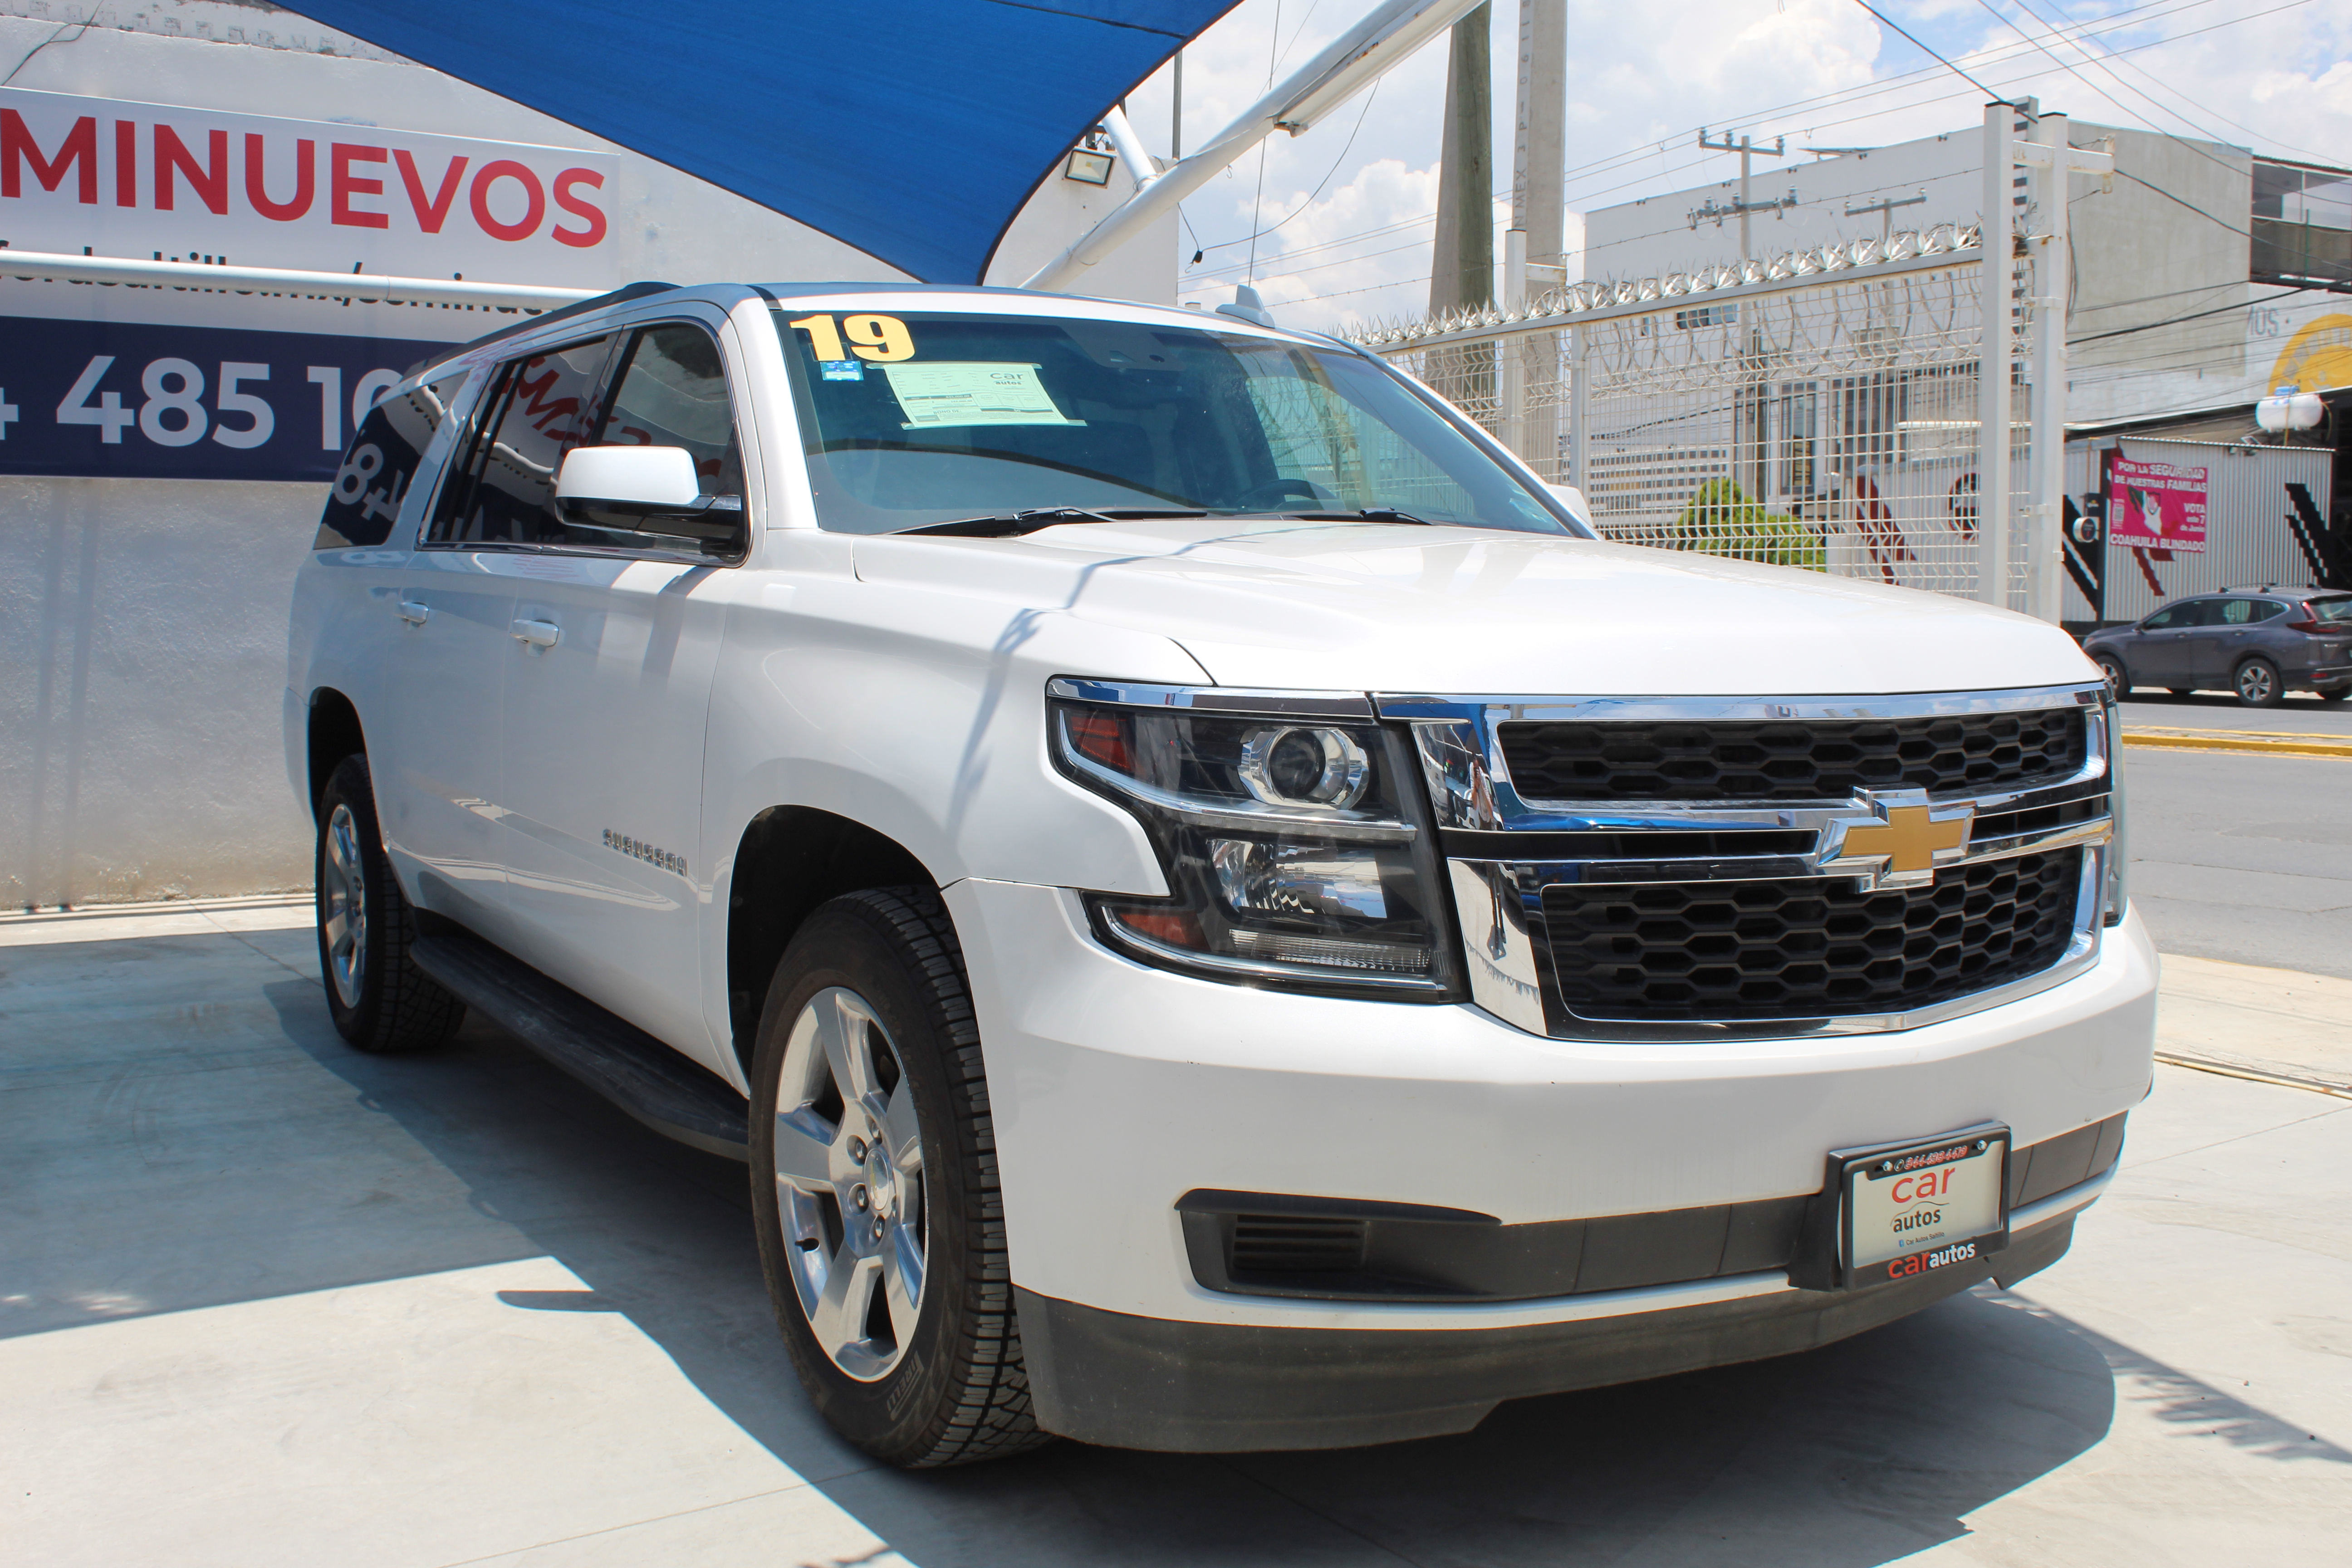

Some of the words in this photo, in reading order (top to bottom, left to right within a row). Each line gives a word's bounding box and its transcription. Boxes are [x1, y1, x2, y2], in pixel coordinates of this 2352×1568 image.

[0, 108, 607, 248] MINUEVOS
[789, 314, 916, 362] 19
[57, 355, 274, 449] 485
[2118, 462, 2136, 473] POR
[2137, 465, 2148, 474] LA
[2149, 465, 2205, 480] SEGURIDAD
[2114, 475, 2126, 484] DE
[2127, 477, 2165, 489] NUESTRAS
[2166, 479, 2207, 493] FAMILIAS
[2184, 503, 2206, 514] VOTA
[2200, 515, 2205, 524] 7
[2110, 534, 2158, 548] COAHUILA
[2160, 538, 2205, 552] BLINDADO
[1891, 1167, 1955, 1203] car
[1893, 1209, 1941, 1232] autos
